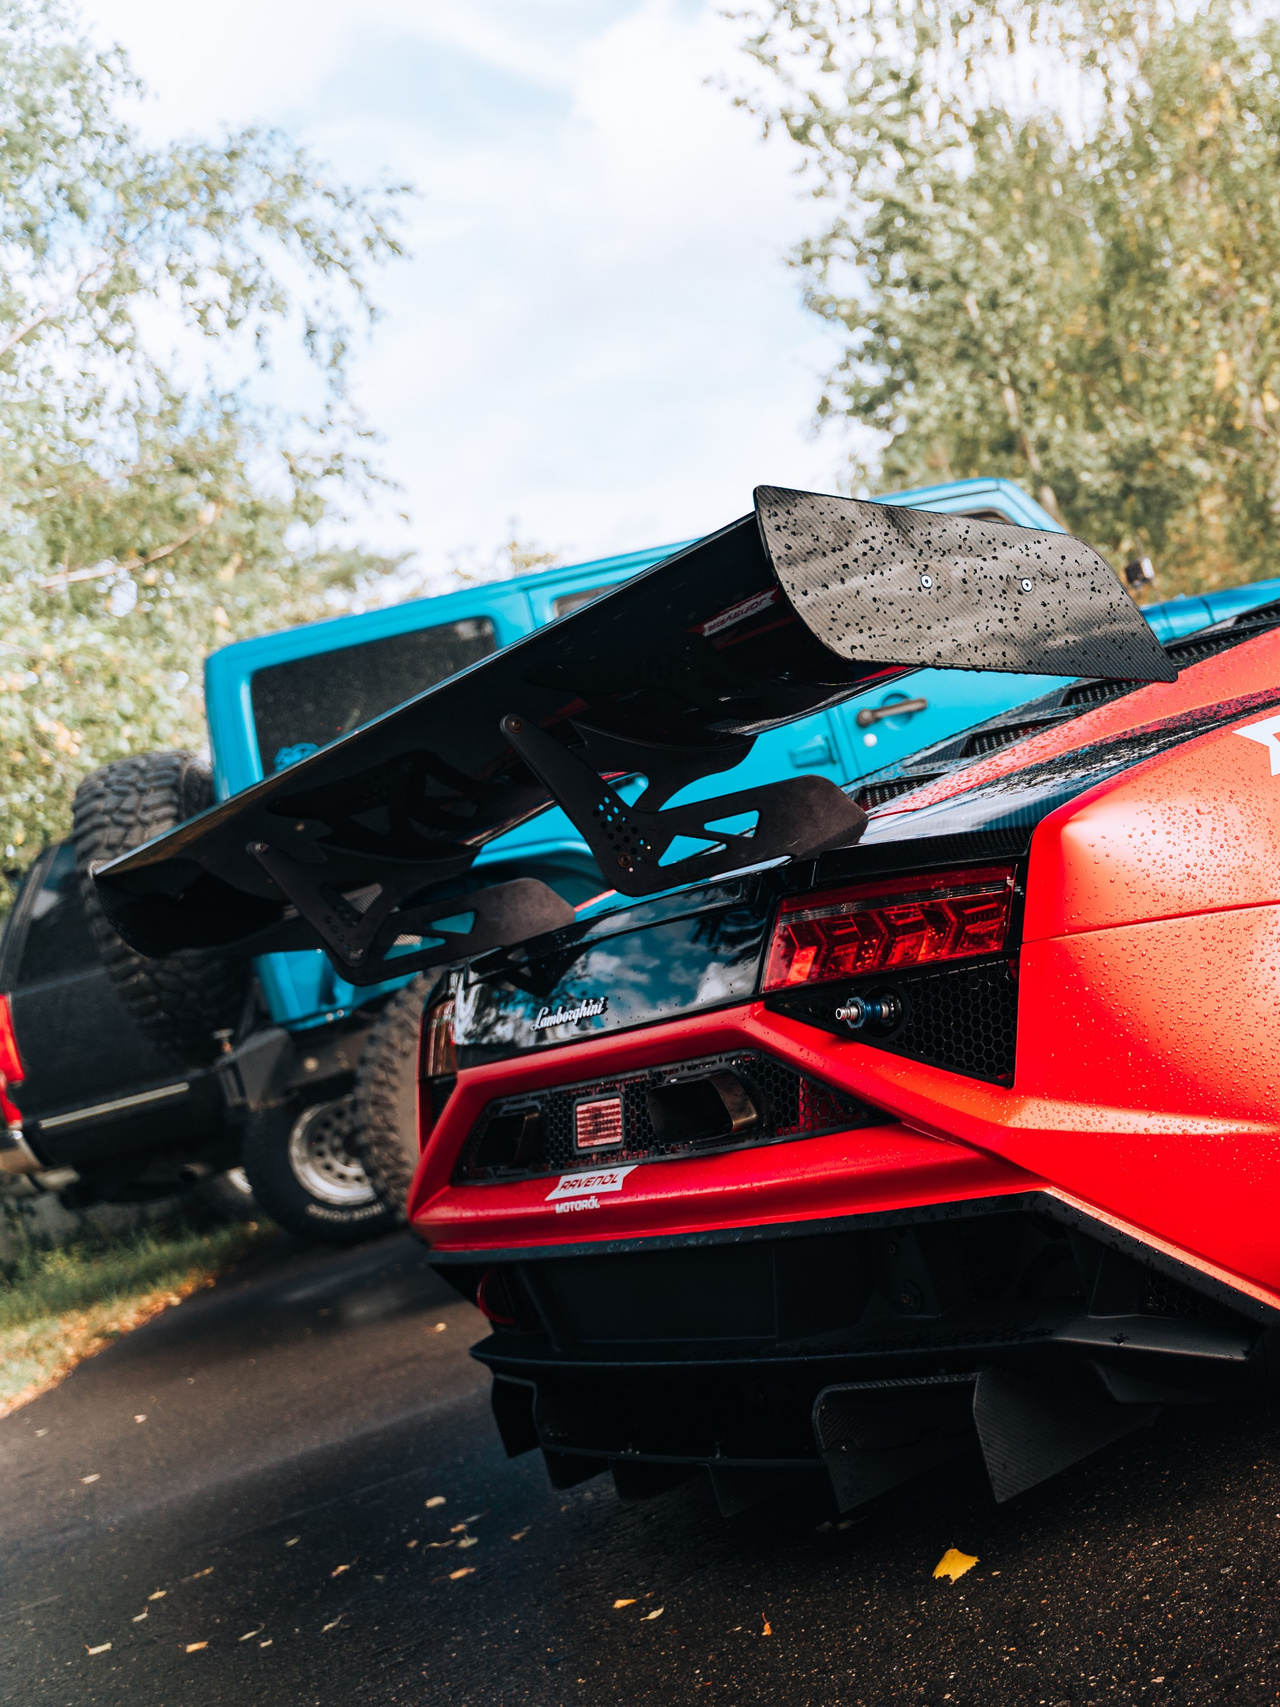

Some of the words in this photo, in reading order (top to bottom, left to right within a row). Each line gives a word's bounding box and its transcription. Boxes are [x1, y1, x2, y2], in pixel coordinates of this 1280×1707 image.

[529, 996, 604, 1031] Lamborghini
[559, 1173, 619, 1192] RAVENOL
[555, 1195, 601, 1214] MOTORÖL
